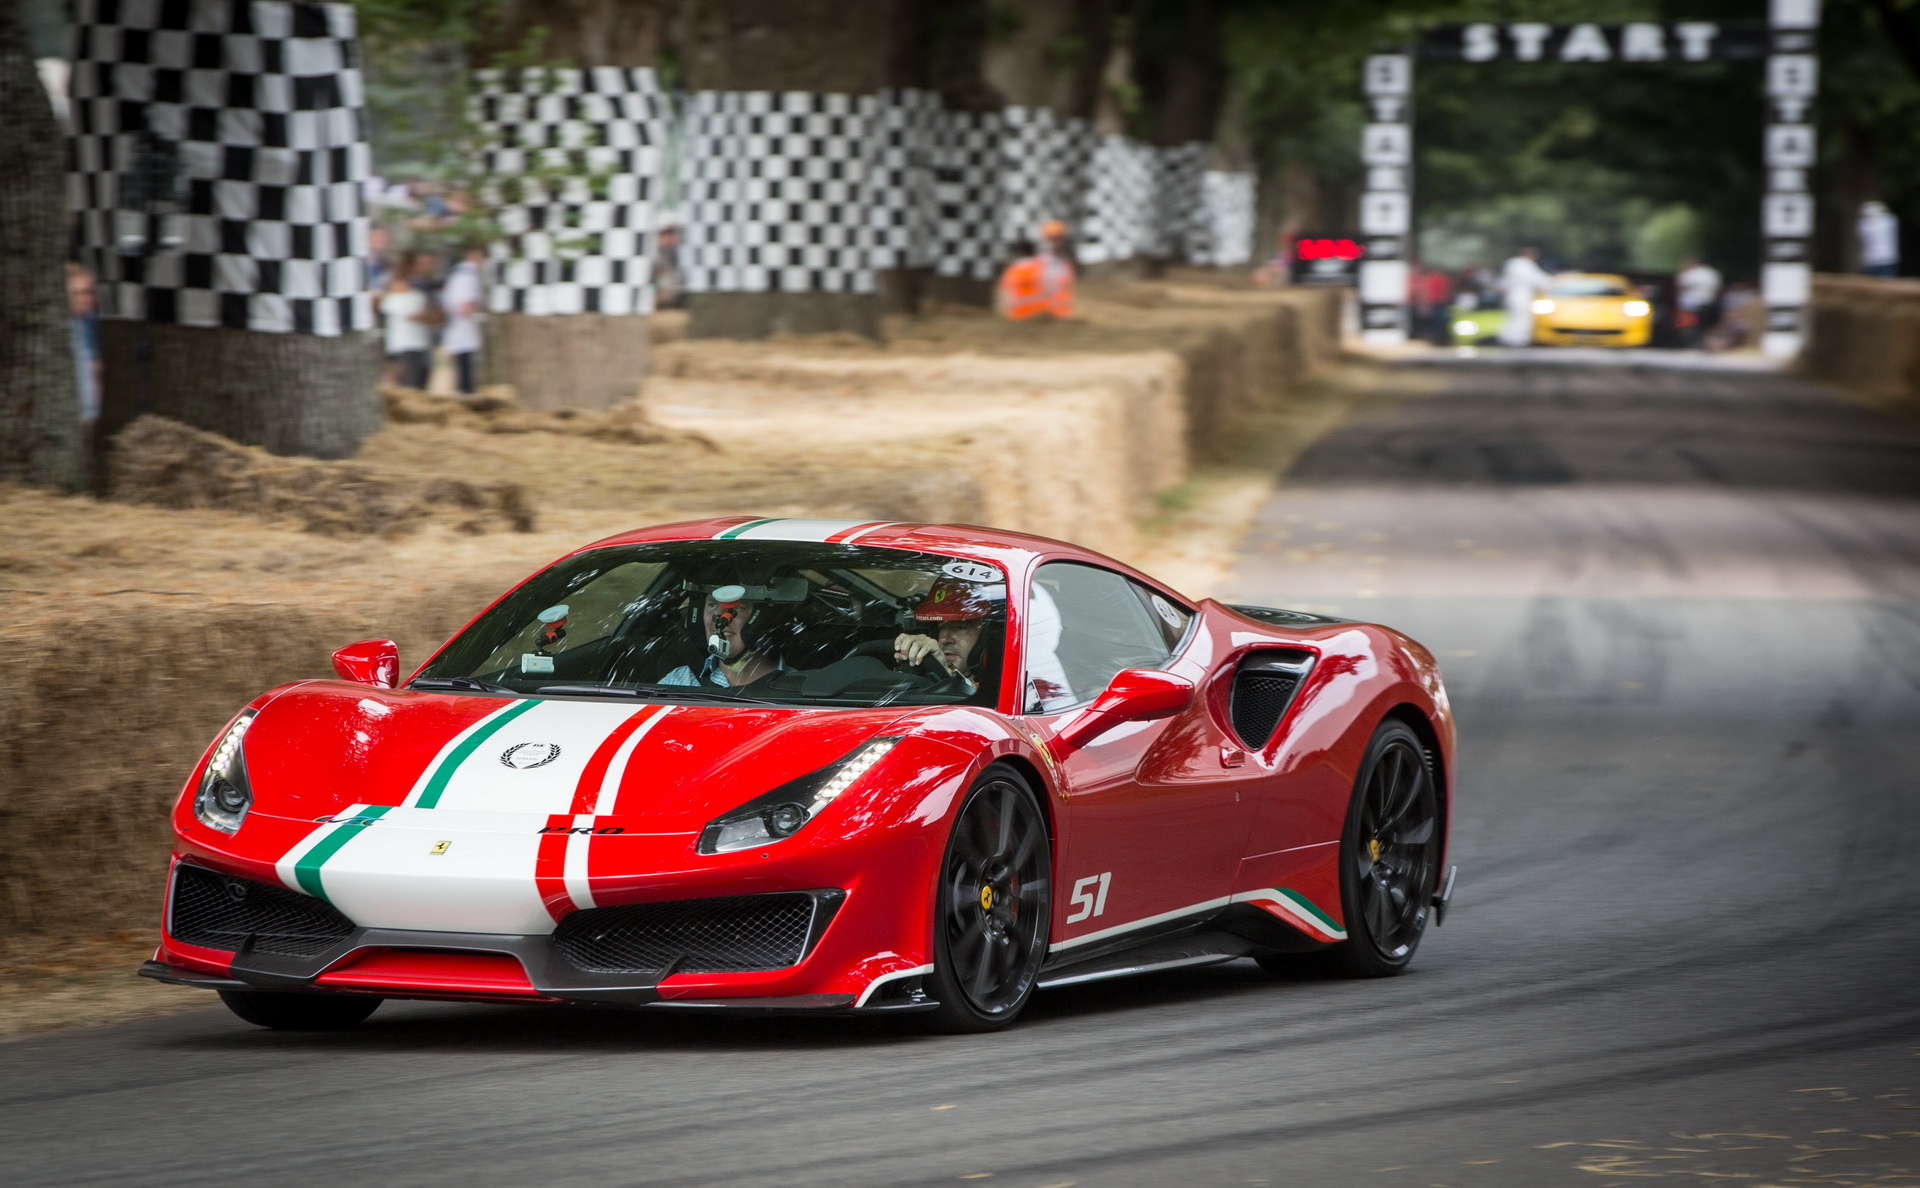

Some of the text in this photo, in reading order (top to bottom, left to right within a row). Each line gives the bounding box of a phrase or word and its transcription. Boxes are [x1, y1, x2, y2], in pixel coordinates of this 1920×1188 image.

[1463, 23, 1719, 62] START
[951, 565, 992, 579] 614
[1066, 871, 1112, 924] 51
